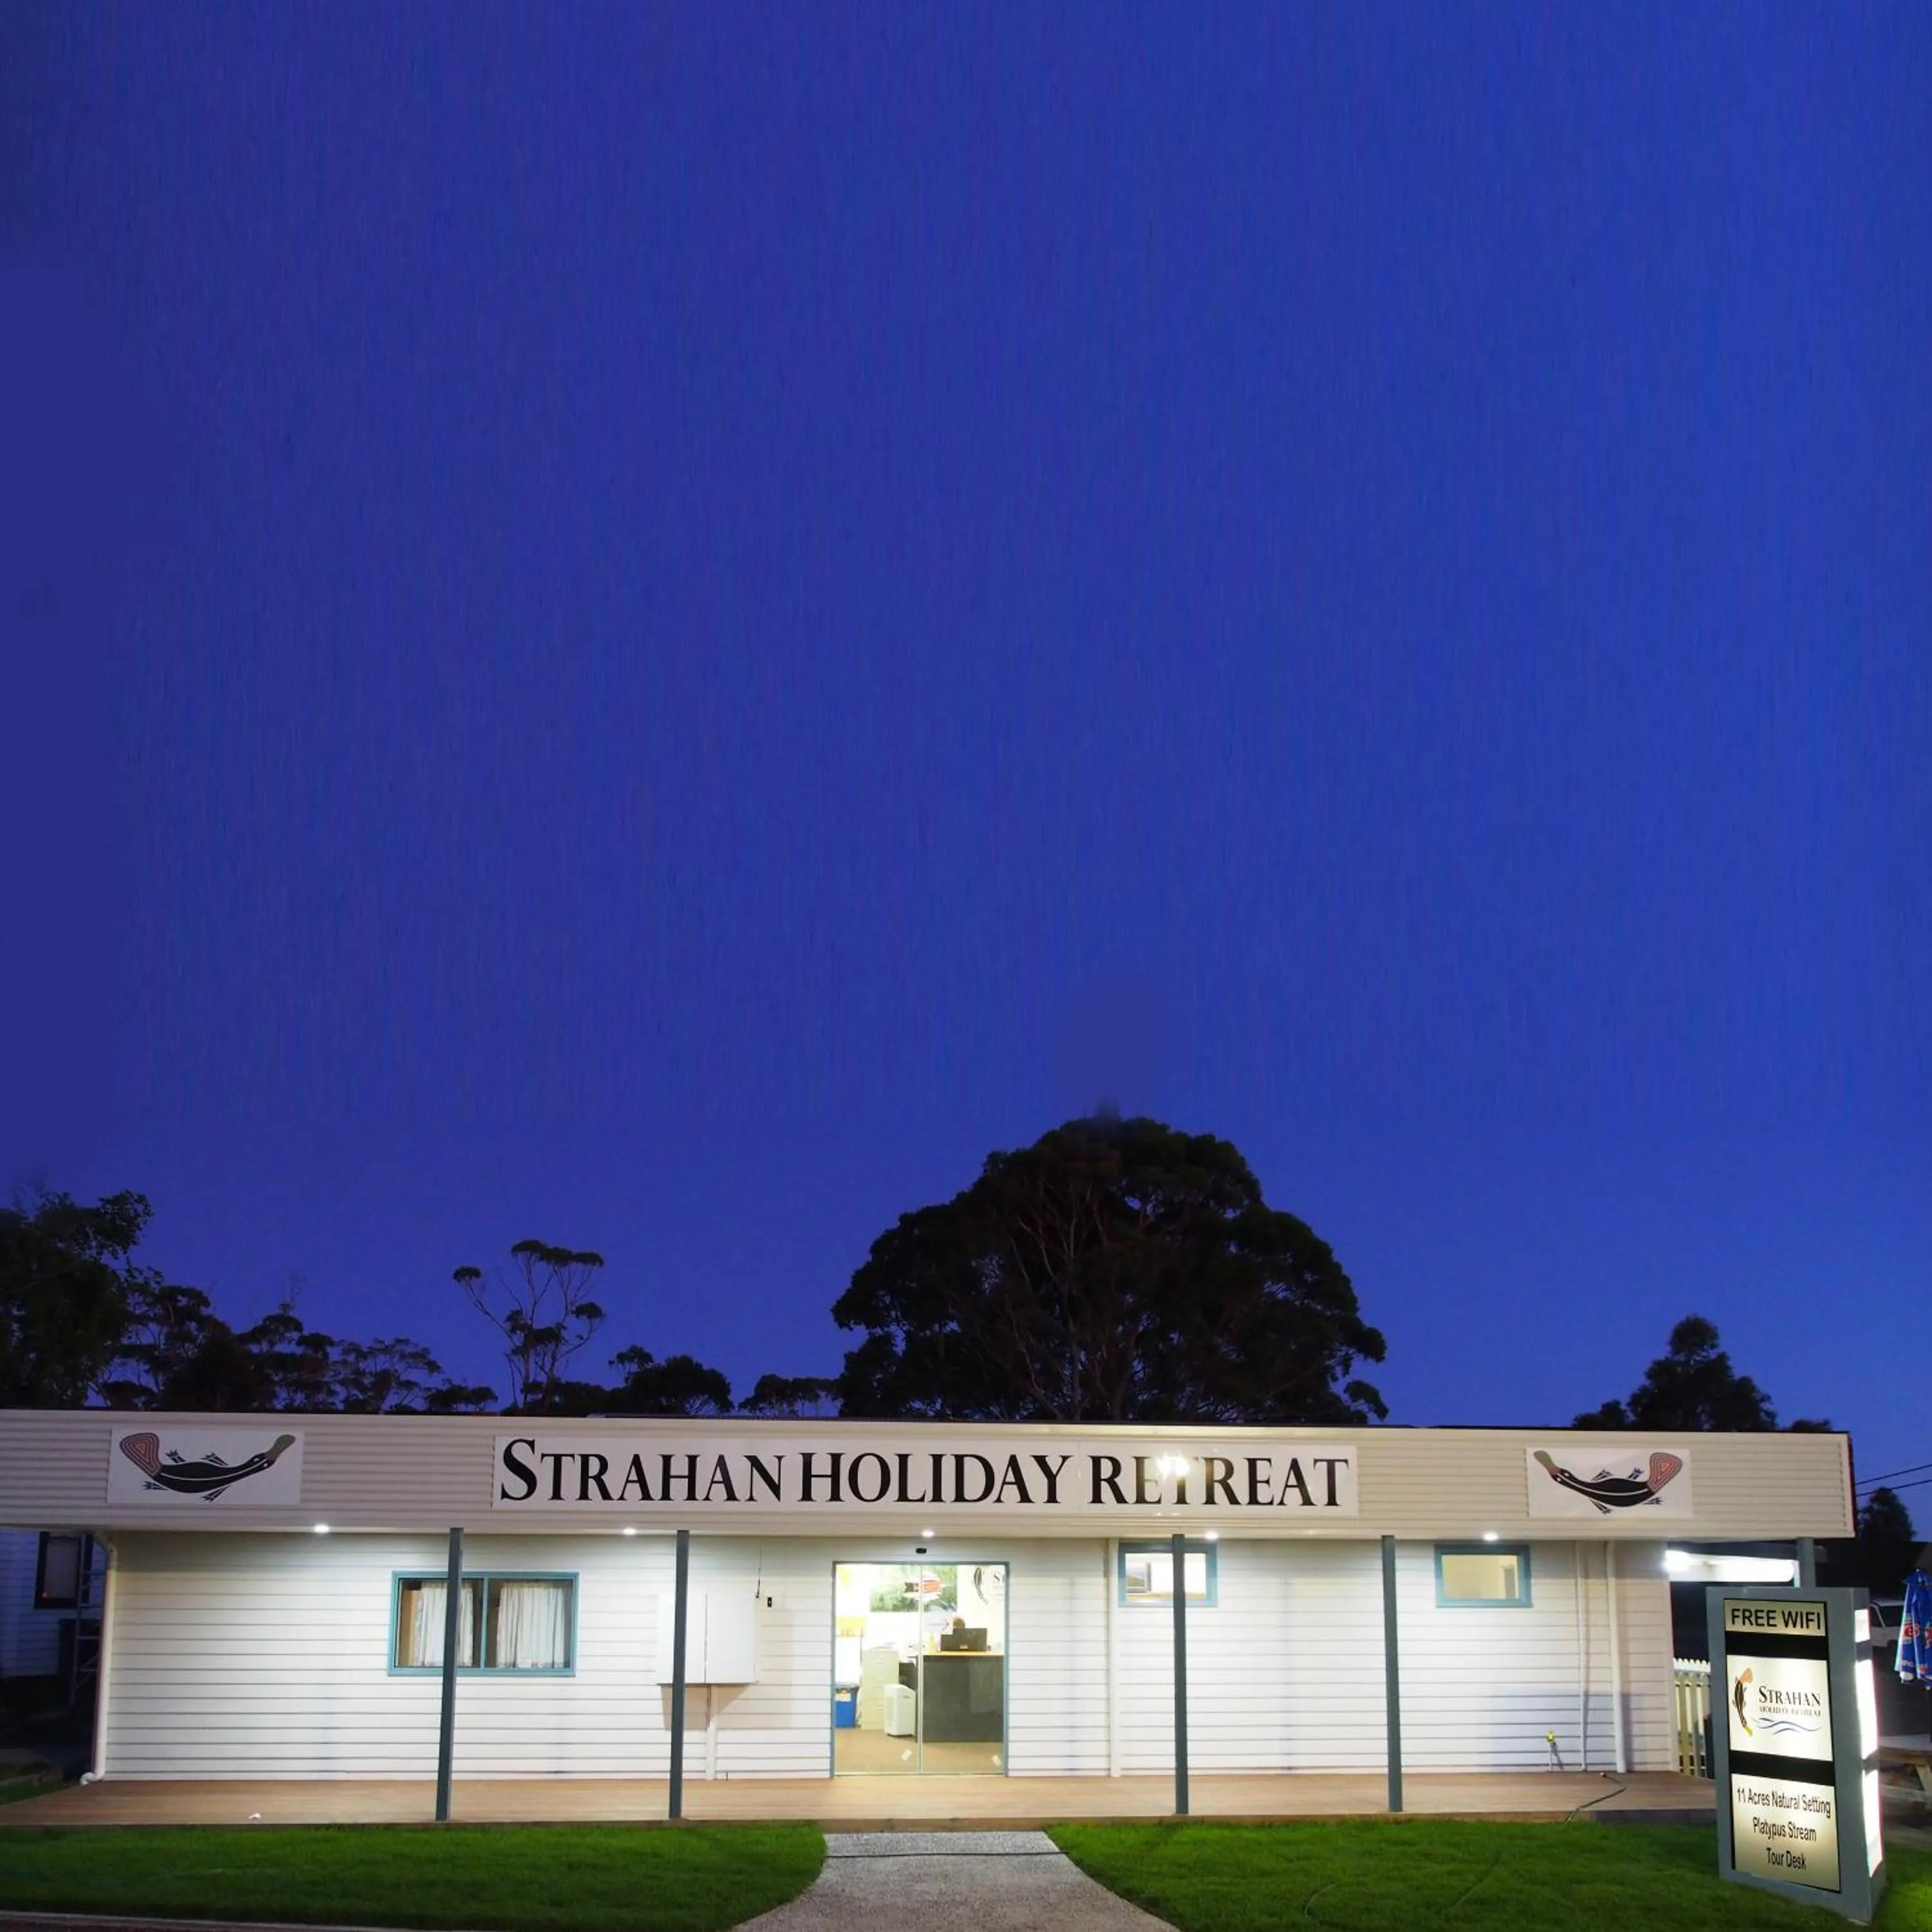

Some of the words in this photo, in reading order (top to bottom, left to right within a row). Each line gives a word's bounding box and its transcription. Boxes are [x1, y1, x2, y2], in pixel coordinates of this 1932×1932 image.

[501, 1439, 785, 1502] STRAHAN
[797, 1452, 1074, 1503] HOLIDAY
[1731, 1609, 1777, 1627] FREE
[1781, 1611, 1821, 1630] WIFI
[1759, 1685, 1821, 1706] STRAHAN
[1737, 1787, 1746, 1803] 11
[1747, 1788, 1770, 1806] Acres
[1772, 1790, 1801, 1810] Natural
[1802, 1794, 1831, 1819] Setting
[1752, 1817, 1786, 1839] Platypus
[1787, 1821, 1817, 1842] Stream
[1766, 1847, 1785, 1866] Tour
[1786, 1850, 1806, 1870] Desk
